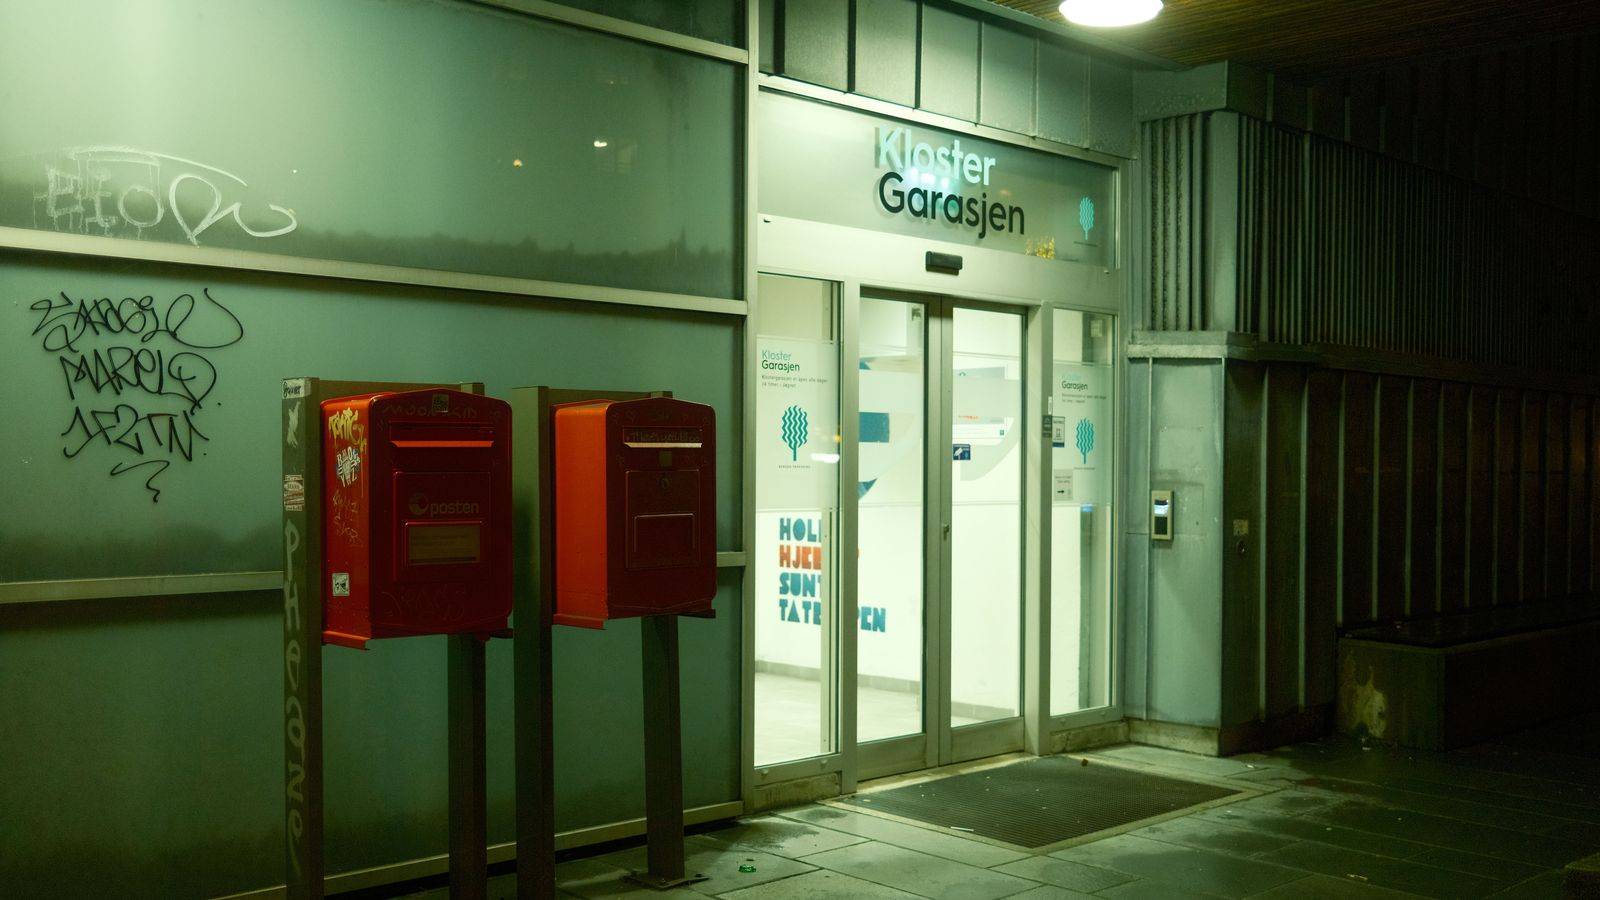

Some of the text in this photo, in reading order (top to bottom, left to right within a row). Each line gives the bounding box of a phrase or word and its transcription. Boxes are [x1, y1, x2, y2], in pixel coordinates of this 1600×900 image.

[878, 125, 997, 186] Kloster
[878, 171, 1025, 240] Garasjen
[761, 350, 792, 361] Kloster
[761, 360, 801, 373] Garasjen
[1061, 380, 1089, 392] Garasjen
[430, 500, 480, 518] posten
